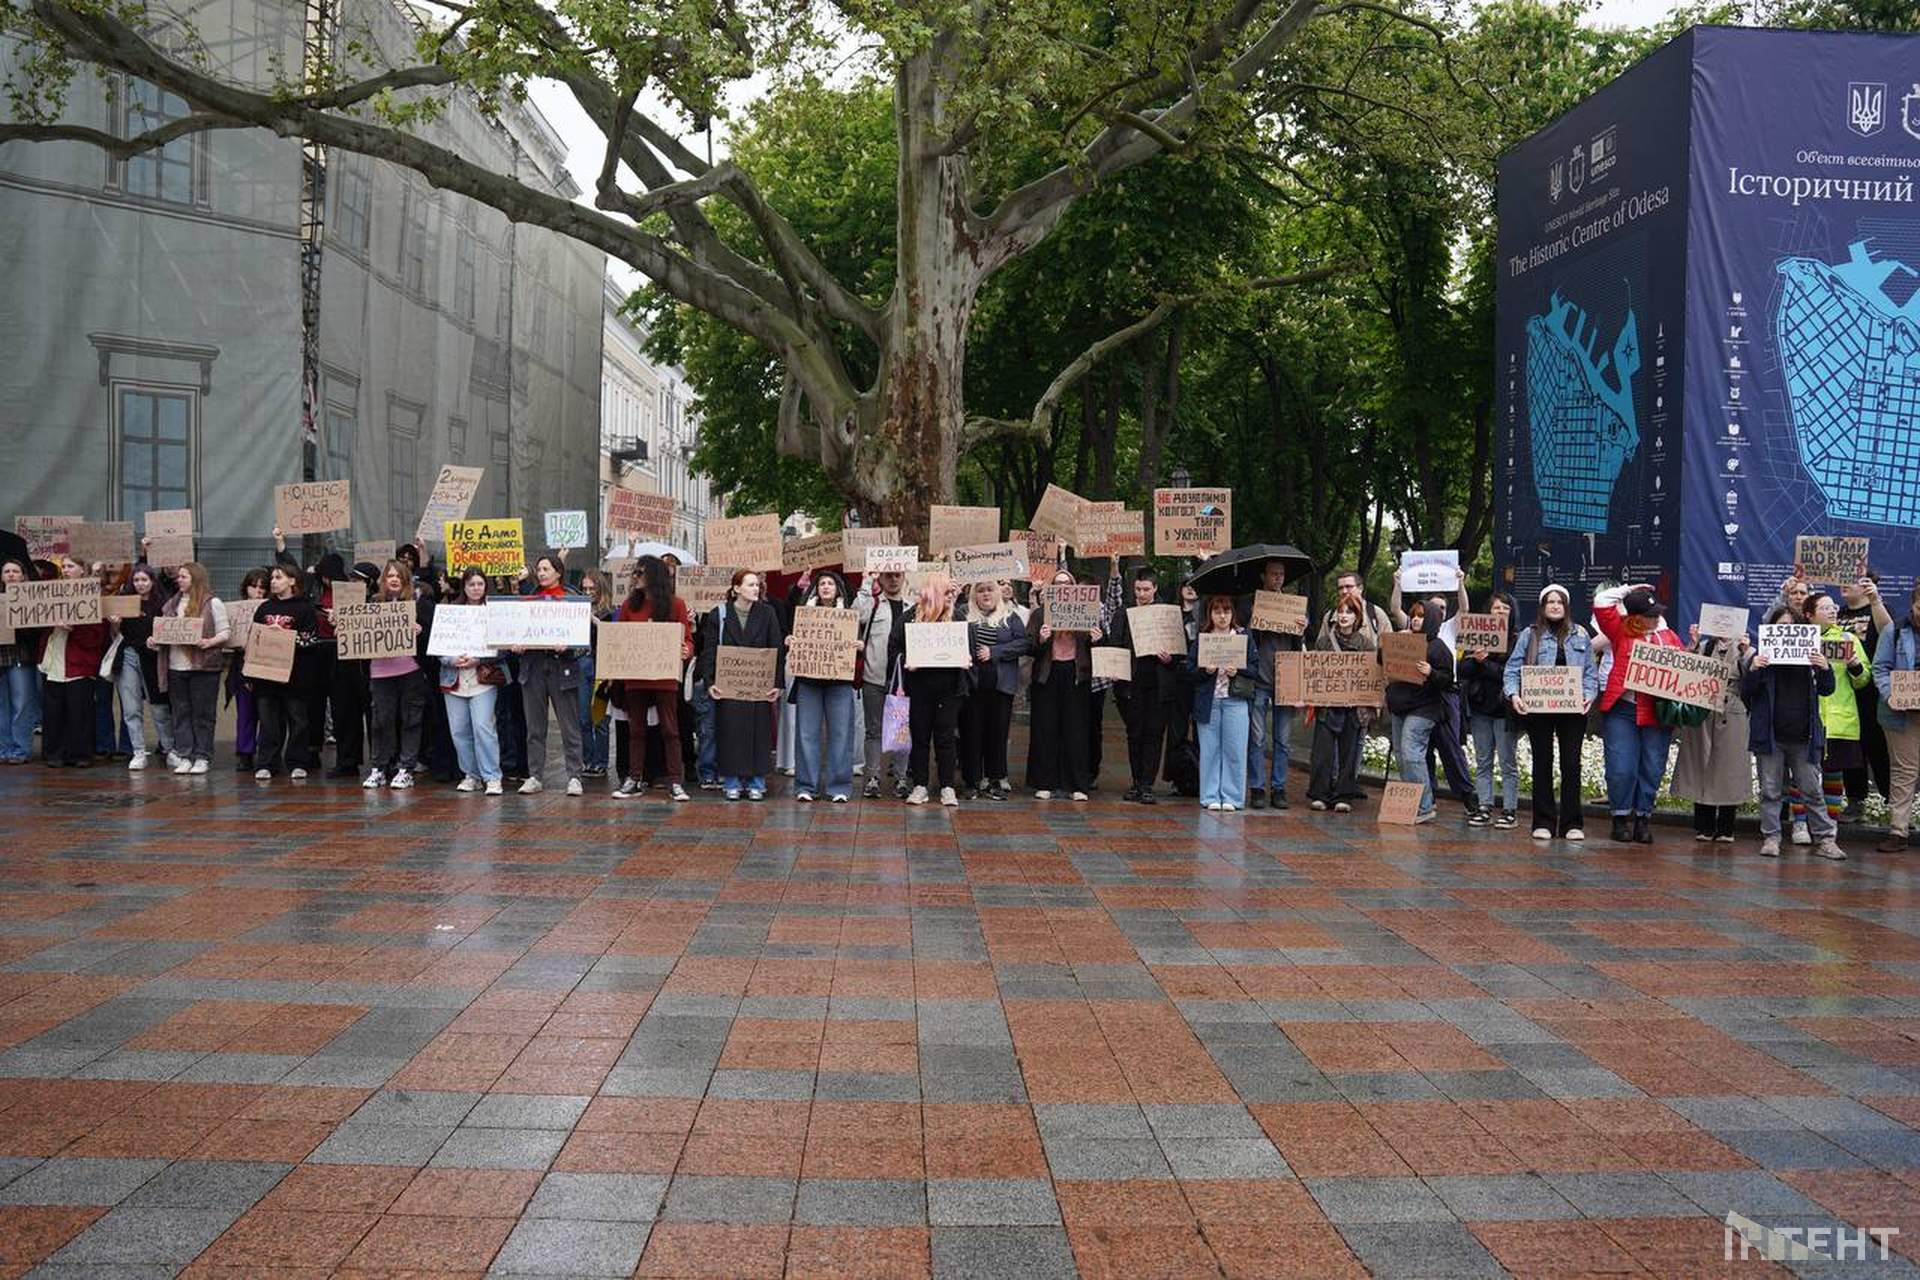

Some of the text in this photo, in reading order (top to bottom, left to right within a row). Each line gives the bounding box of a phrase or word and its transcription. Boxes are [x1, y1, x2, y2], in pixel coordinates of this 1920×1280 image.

[1591, 155, 1617, 177] unesco
[1728, 167, 1914, 206] Історичний
[1509, 186, 1669, 277] The Historic Centre of Odesa
[1158, 493, 1171, 503] НЕ
[9, 585, 19, 602] З
[1046, 587, 1098, 602] #15150
[9, 599, 98, 626] МИРИТИСЯ
[339, 604, 381, 616] #15150
[338, 614, 409, 631] ЗНУЩАННЯ
[1460, 616, 1506, 632] ГАНЬБА
[1456, 633, 1499, 647] #15150
[1766, 626, 1817, 638] 15150?
[338, 629, 413, 656] З НАРОДУ
[1634, 644, 1729, 680] НЕДОБРОЗВИЧАЙНО
[1627, 663, 1680, 693] ПРОТИ
[1306, 680, 1324, 695] НЕ
[1326, 682, 1345, 693] БЕЗ
